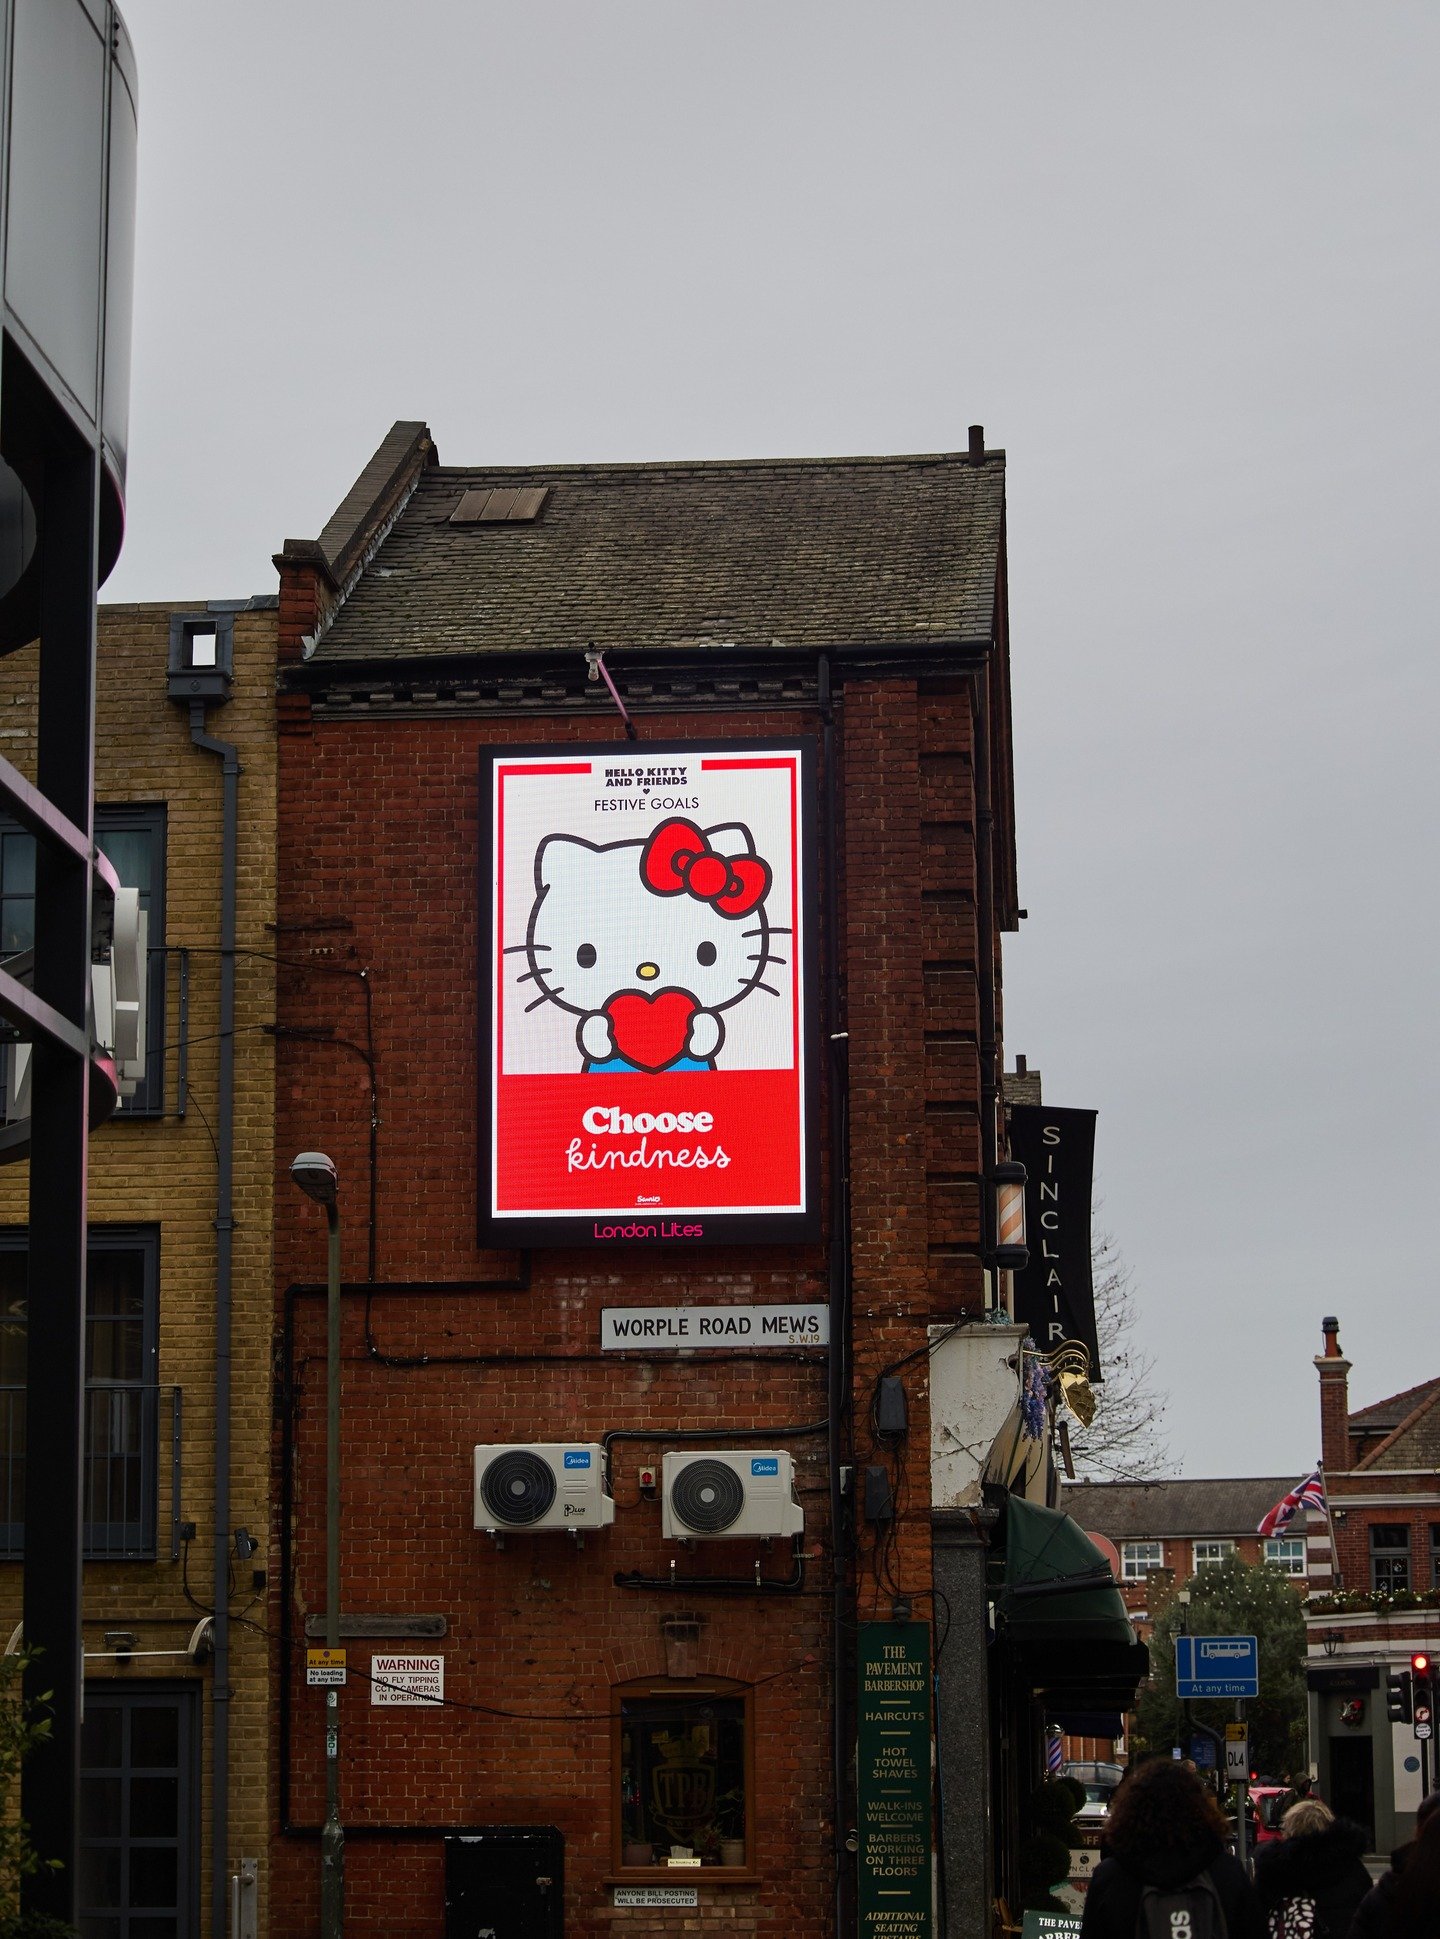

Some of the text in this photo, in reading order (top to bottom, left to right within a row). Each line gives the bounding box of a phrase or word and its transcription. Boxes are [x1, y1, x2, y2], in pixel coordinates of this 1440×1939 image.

[605, 767, 687, 777] HELLO KITTY
[605, 777, 688, 787] AND FRIENDS
[594, 797, 699, 811] FESTIVE GOALS
[582, 1106, 714, 1134] Choose
[565, 1136, 731, 1173] kindness
[594, 1222, 704, 1238] London Lites
[1040, 1126, 1067, 1341] SINCLAIR
[613, 1316, 820, 1336] WORPLE ROAD MEWS
[788, 1334, 820, 1344] S.W.19
[566, 1456, 589, 1465] Midea
[753, 1462, 777, 1472] Midea
[883, 1646, 907, 1659] THE
[376, 1660, 440, 1670] WARNING
[866, 1662, 923, 1676] PAVEMENT
[376, 1676, 439, 1684] NO FLY TIPPING
[864, 1680, 925, 1691] BARBERSHOP
[1192, 1684, 1246, 1694] At any time
[865, 1712, 925, 1721] HAIRCUTS
[883, 1747, 907, 1756] HOT
[874, 1758, 916, 1767] TOWEL
[1228, 1751, 1244, 1766] DL4
[872, 1769, 918, 1778] SHAVES
[868, 1801, 922, 1810] WALK-INS
[866, 1812, 924, 1821] WELCOME
[869, 1834, 921, 1843] BARBERS
[866, 1845, 924, 1854] WORKING
[866, 1856, 925, 1865] ON THREE
[873, 1867, 918, 1876] FLOORS
[865, 1912, 926, 1921] ADDITIONAL
[874, 1923, 918, 1932] SEATING
[1039, 1918, 1056, 1927] THE
